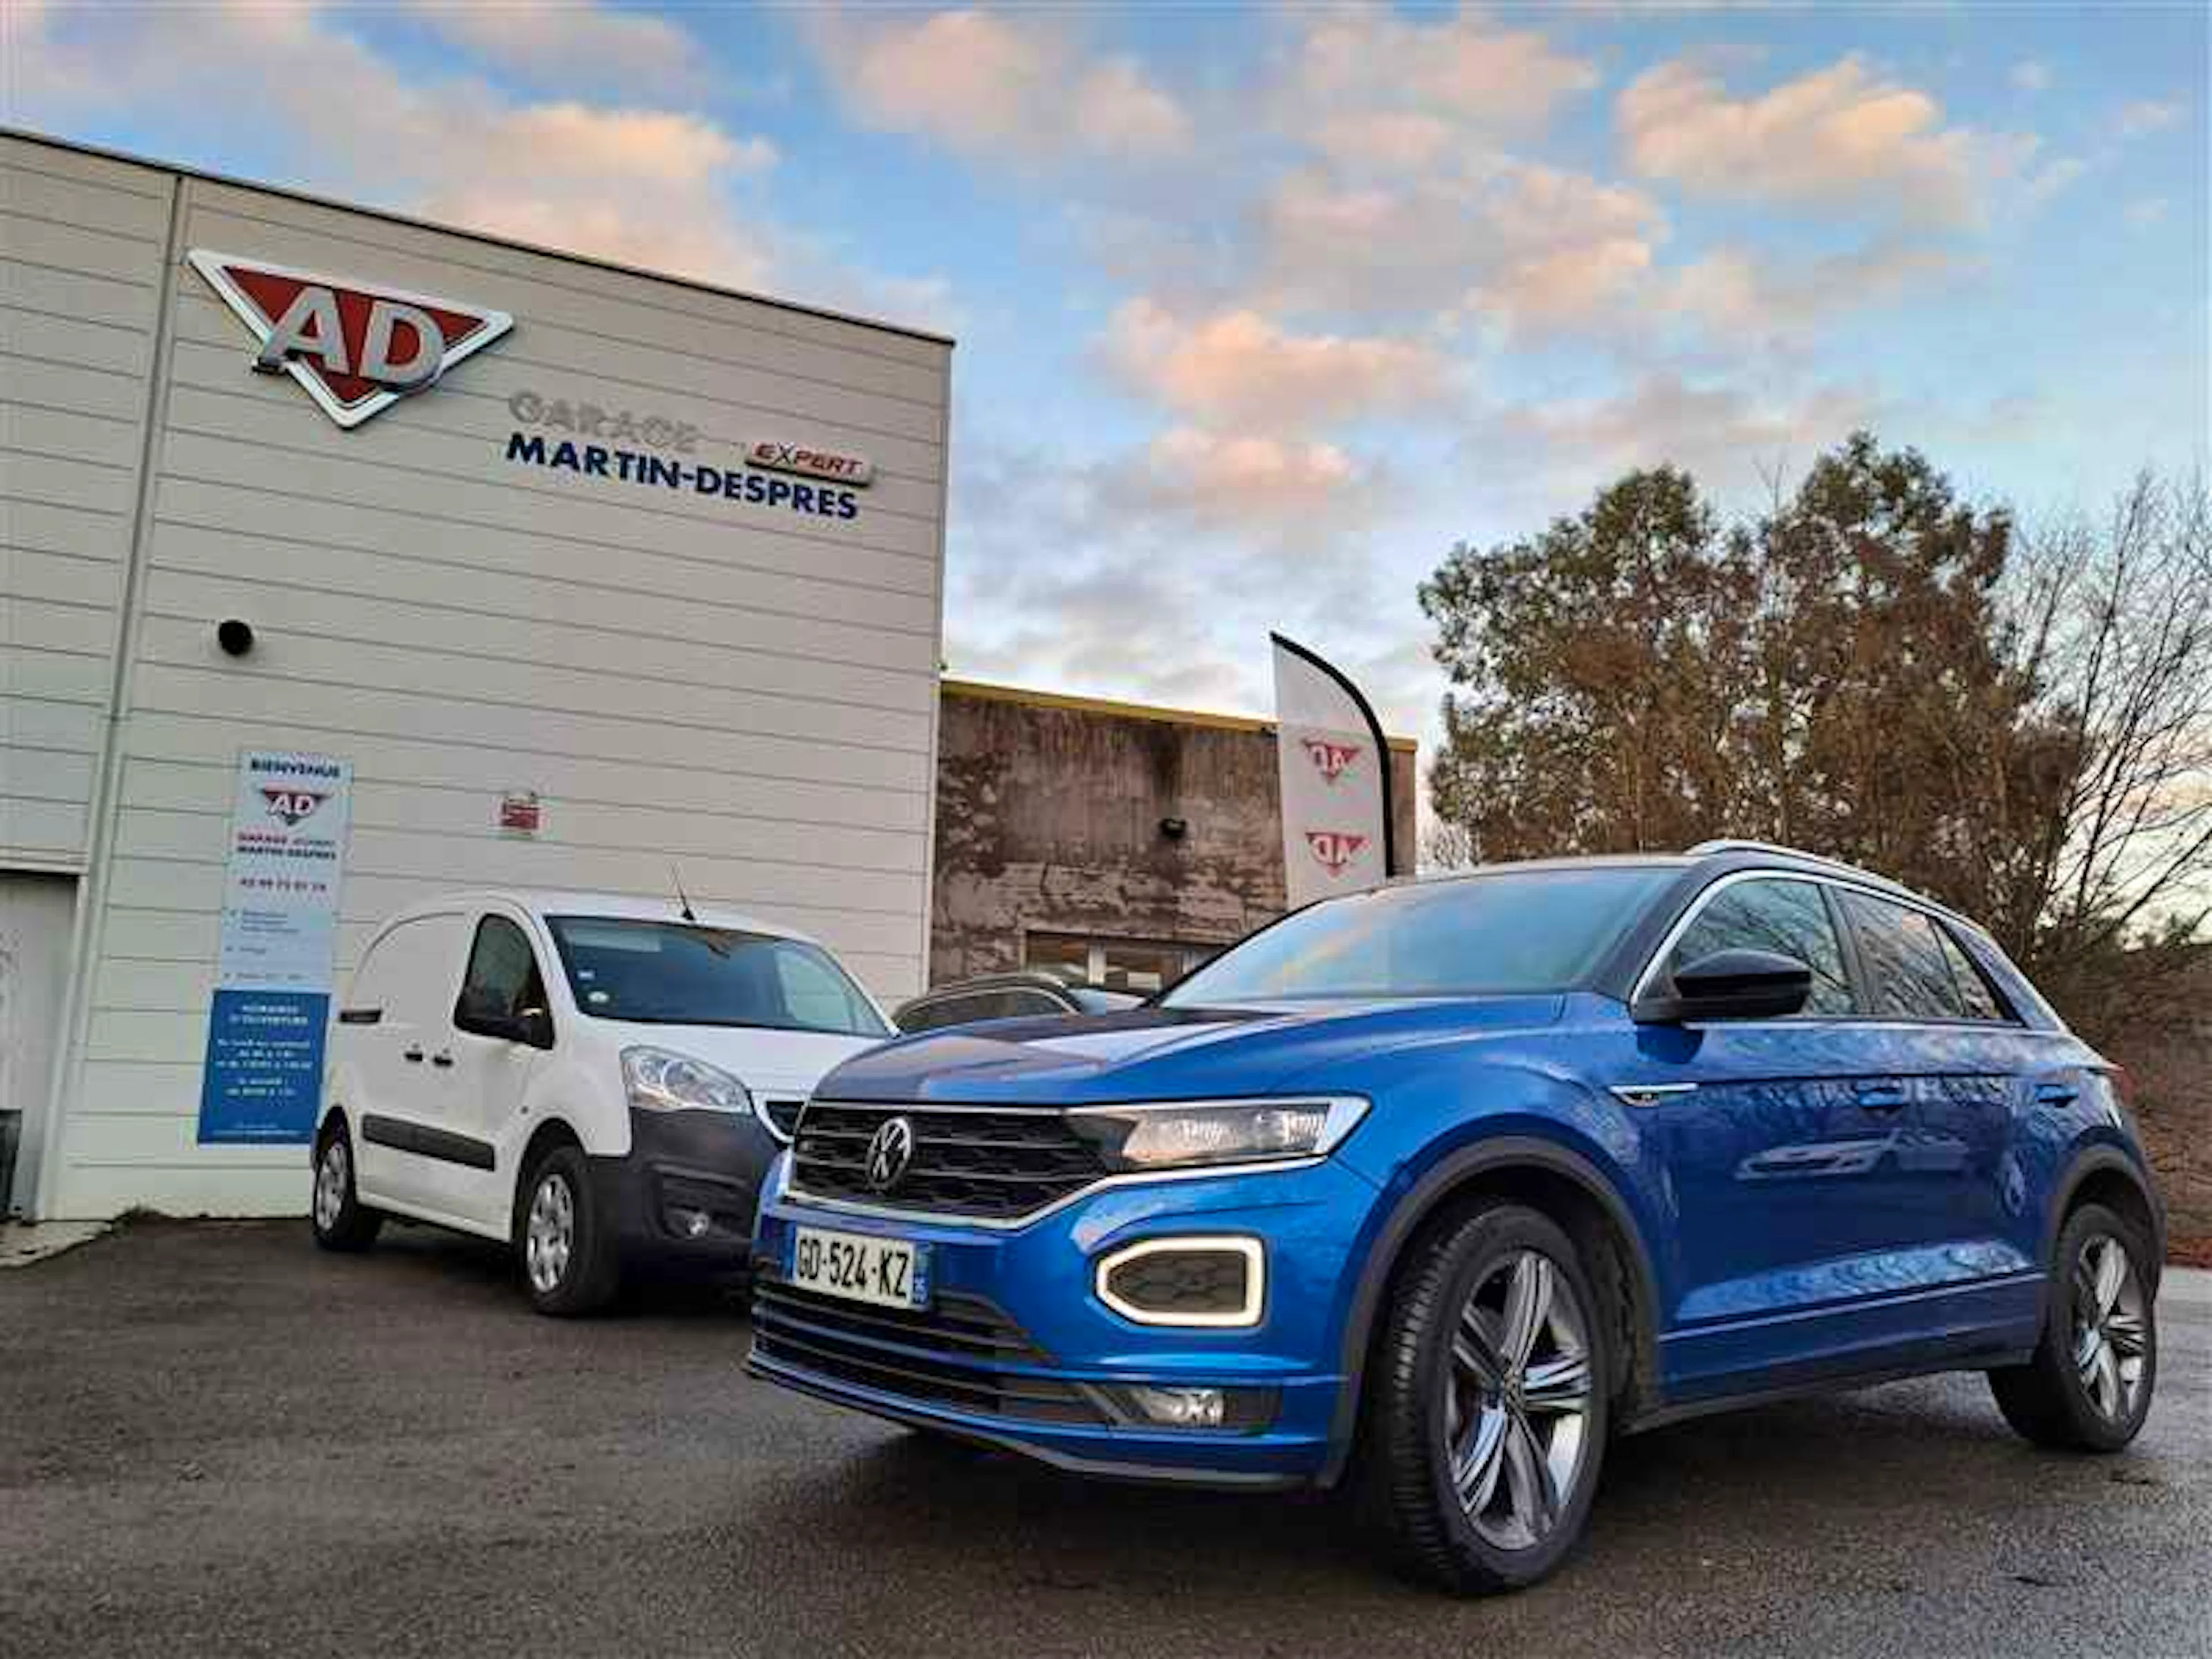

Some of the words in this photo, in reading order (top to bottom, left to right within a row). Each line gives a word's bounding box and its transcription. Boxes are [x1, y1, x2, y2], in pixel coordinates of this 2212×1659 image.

[262, 285, 444, 385] AD
[508, 391, 699, 453] GARAGE
[506, 431, 858, 520] MARTIN-DESPRES
[271, 793, 315, 816] AD
